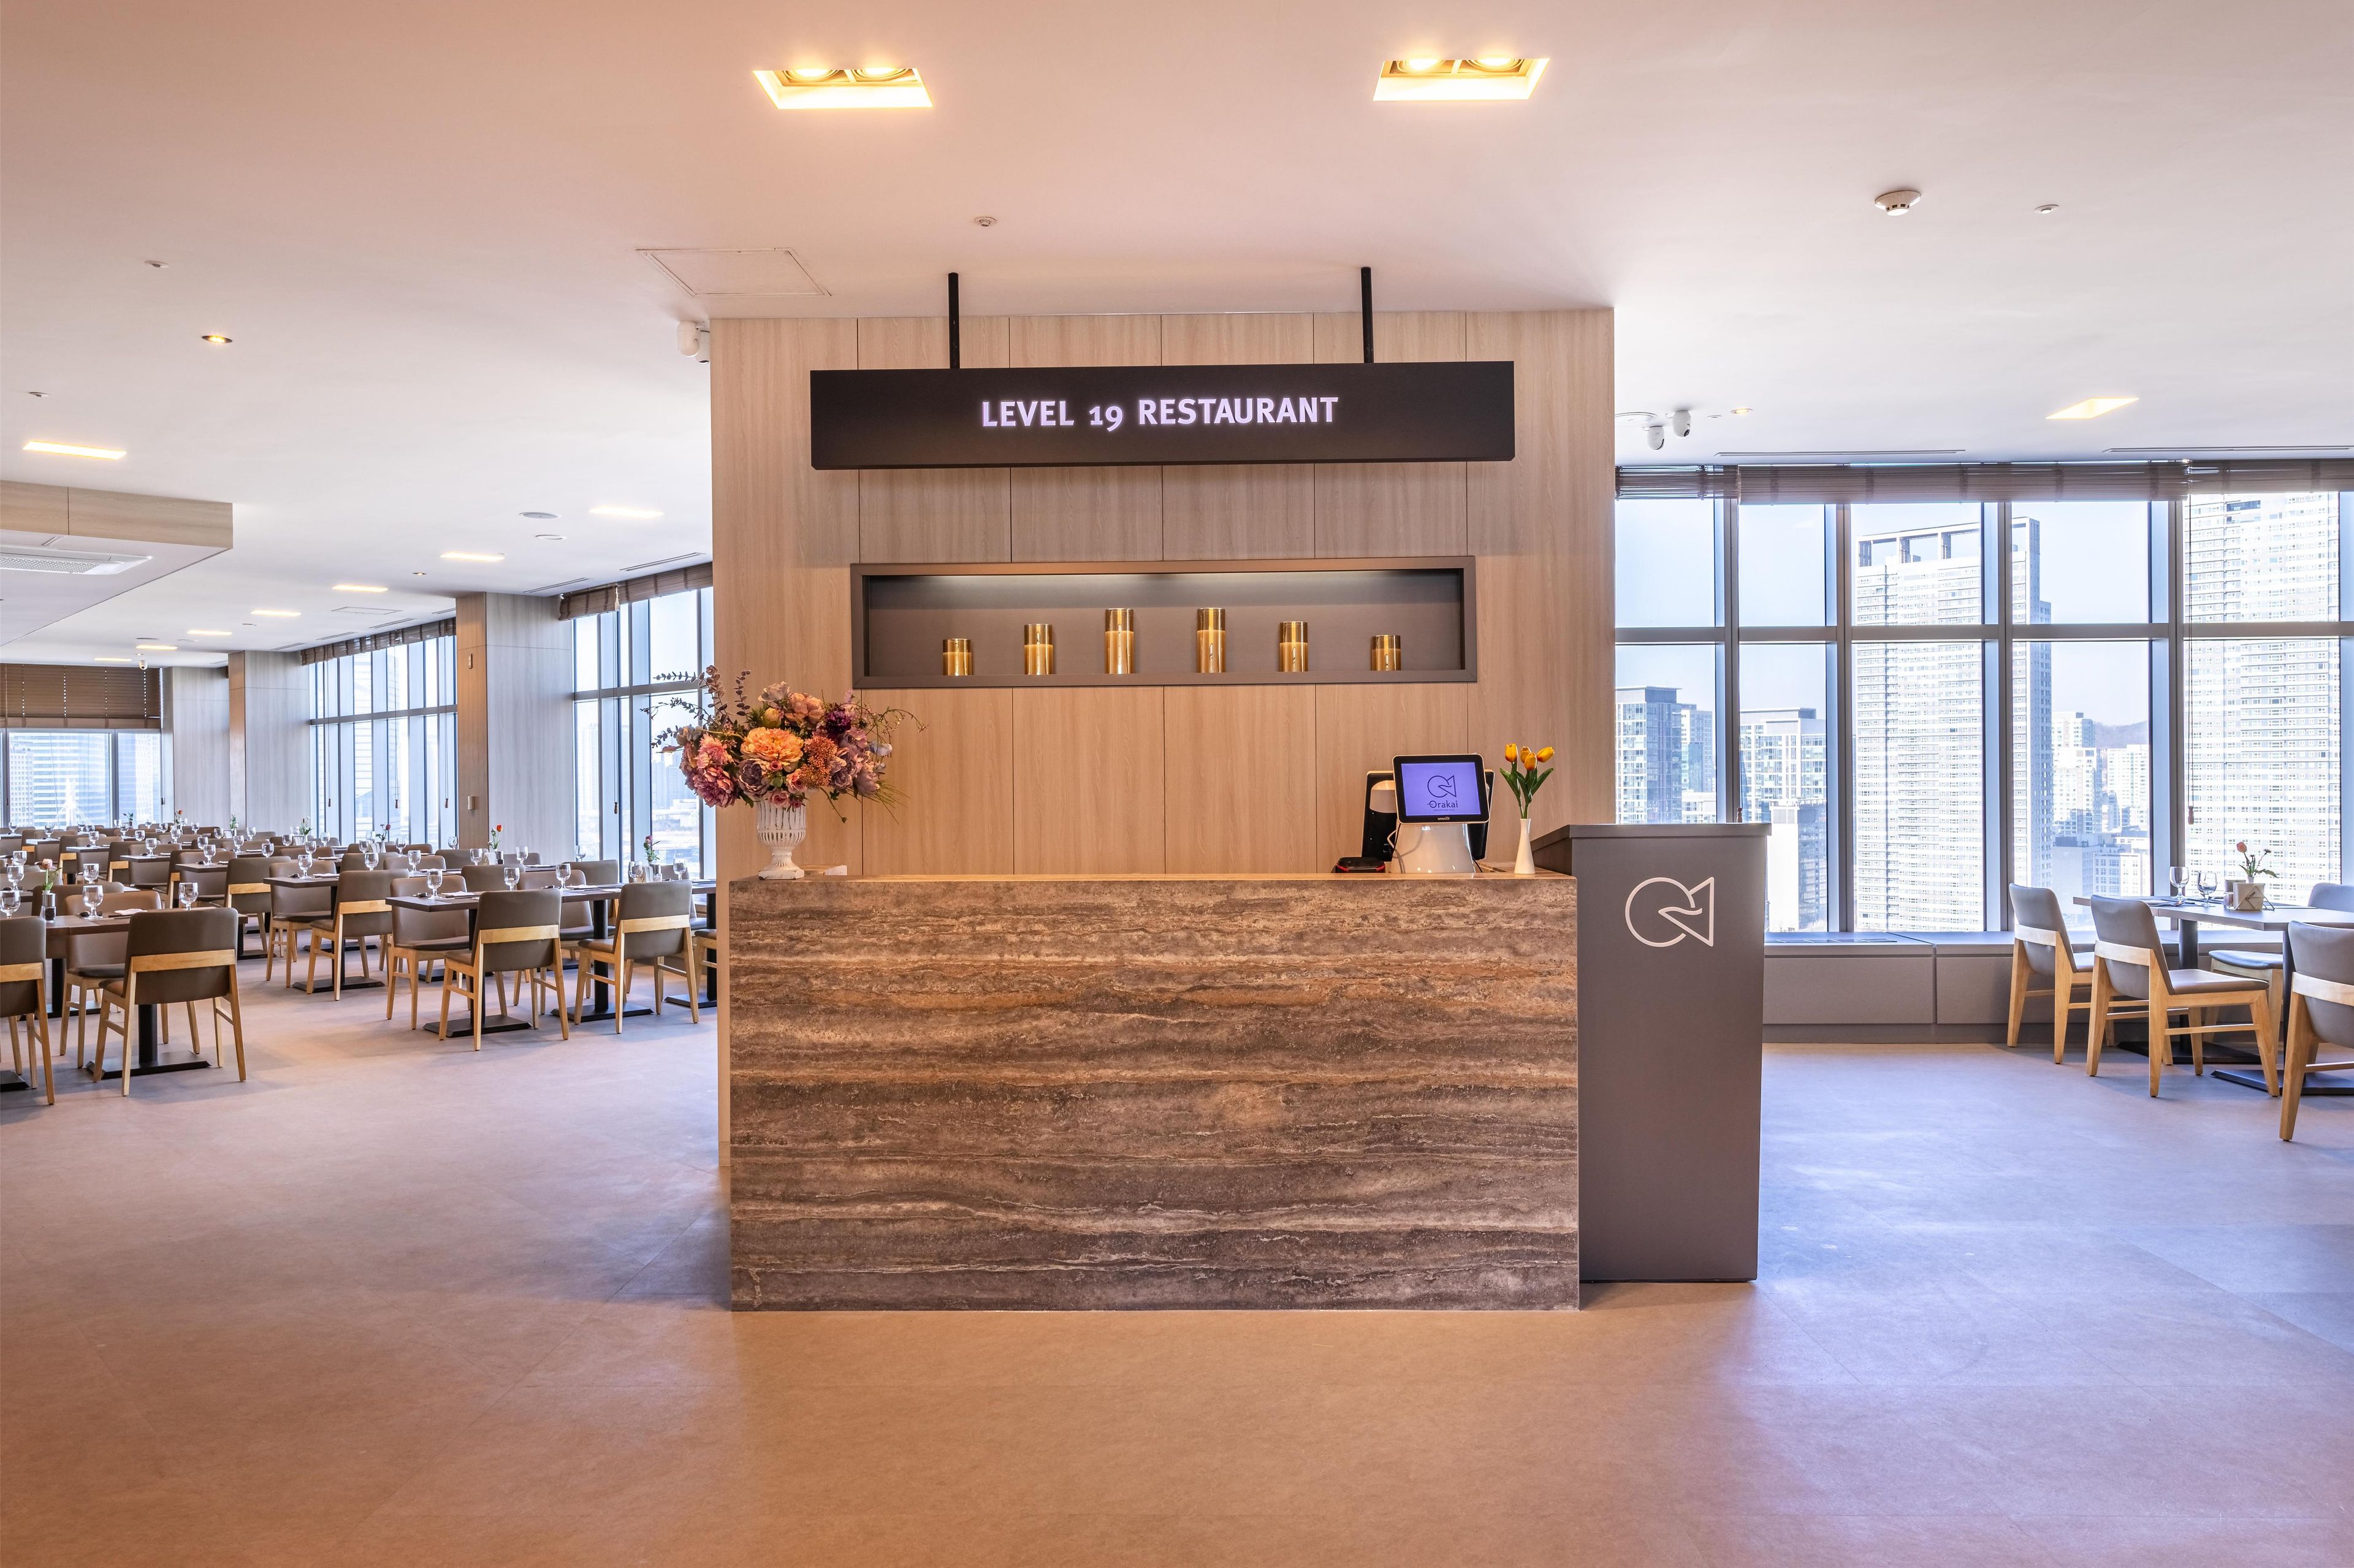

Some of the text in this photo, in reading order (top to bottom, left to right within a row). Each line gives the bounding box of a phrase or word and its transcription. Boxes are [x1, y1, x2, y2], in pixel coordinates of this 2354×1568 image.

[982, 397, 1339, 432] LEVEL 19 RESTAURANT
[1427, 800, 1458, 809] Orakai
